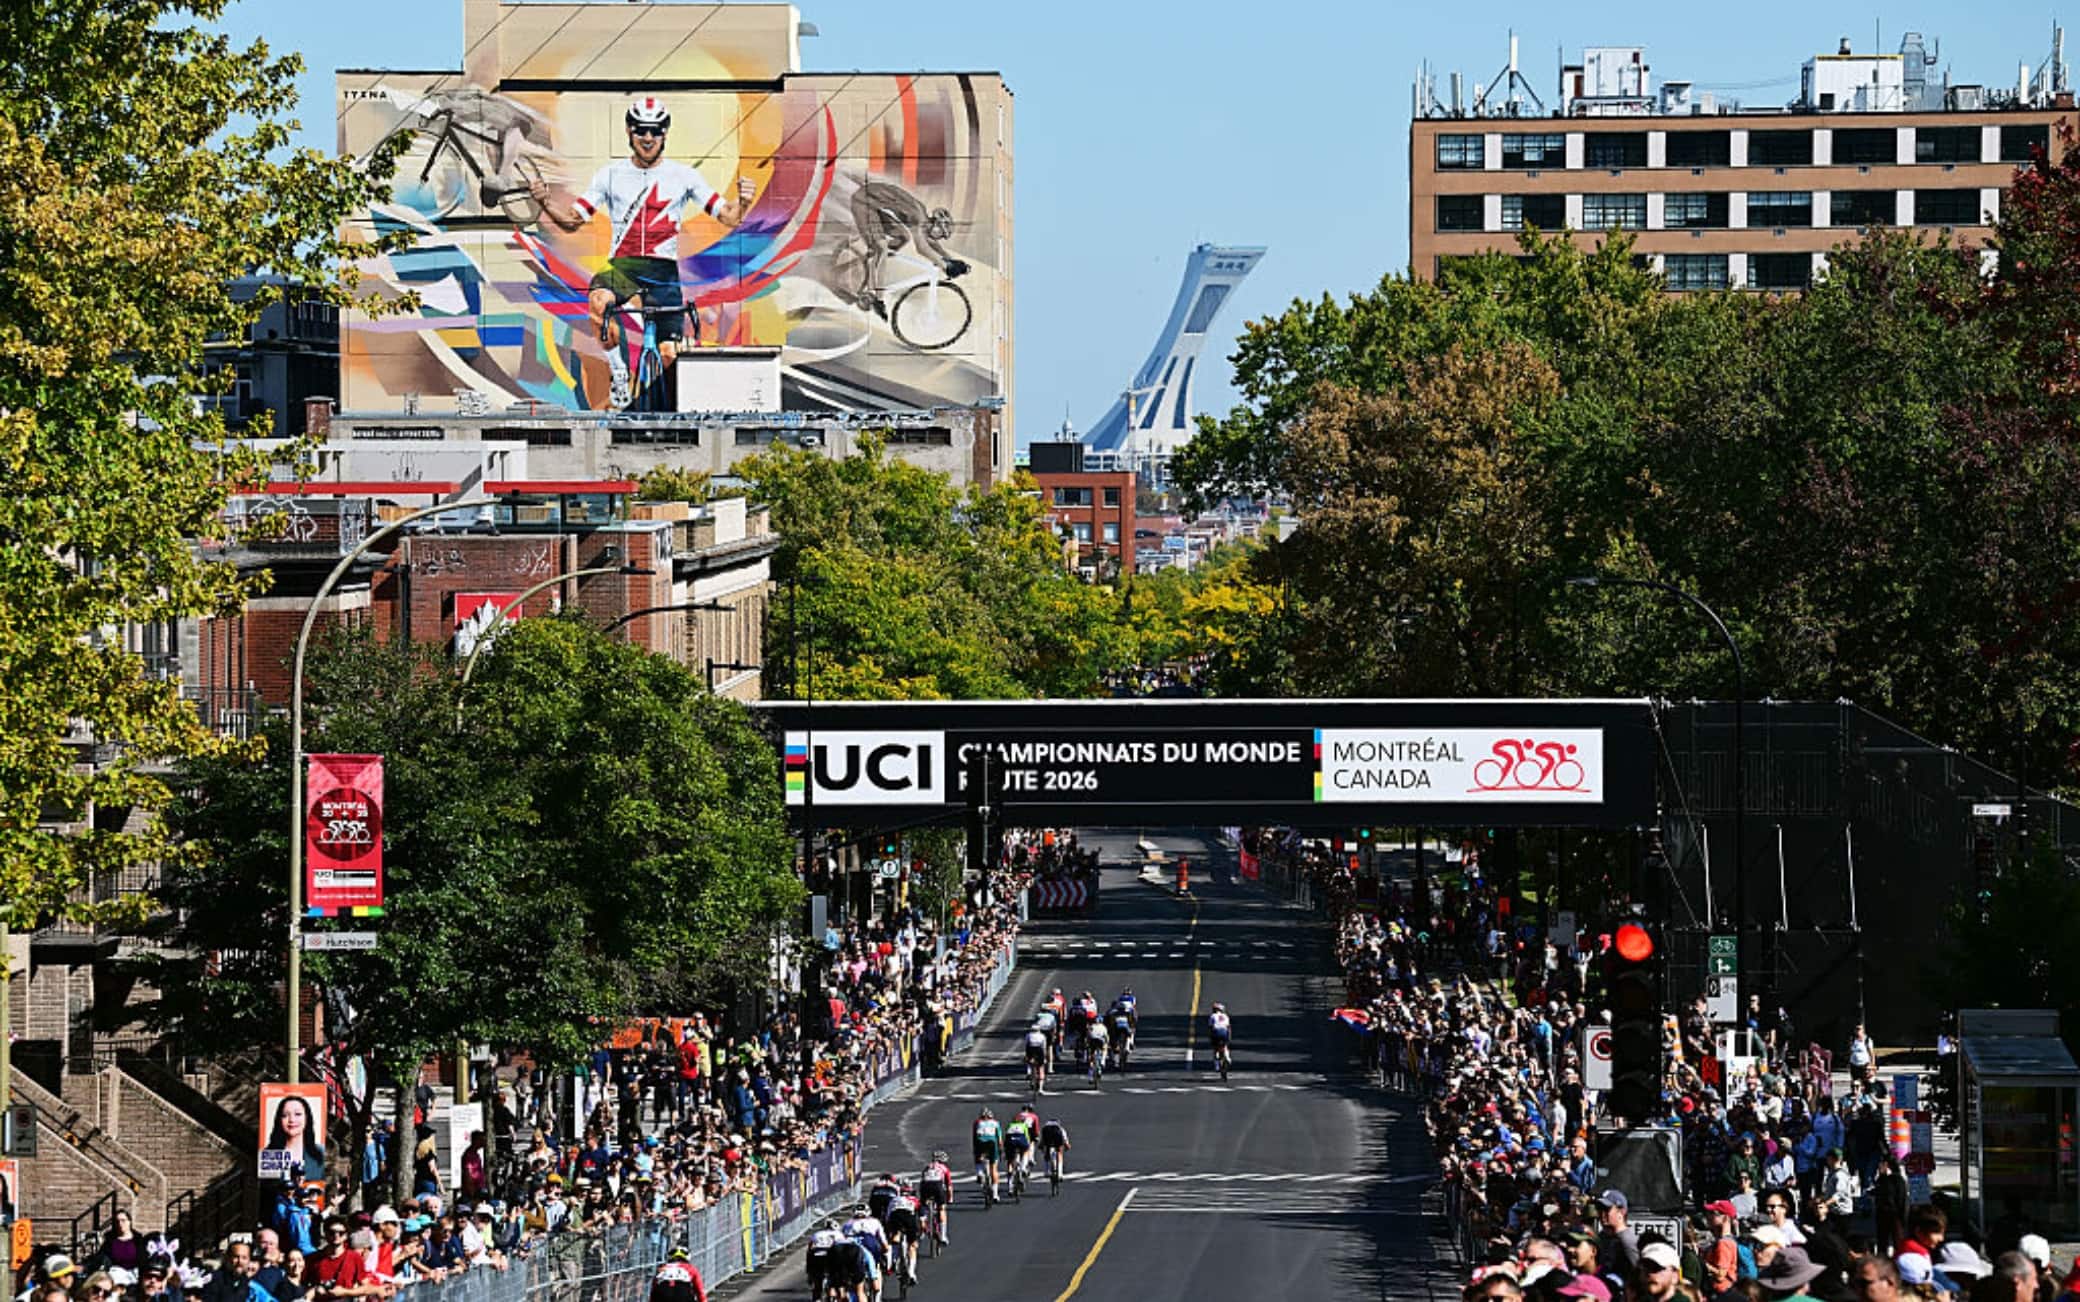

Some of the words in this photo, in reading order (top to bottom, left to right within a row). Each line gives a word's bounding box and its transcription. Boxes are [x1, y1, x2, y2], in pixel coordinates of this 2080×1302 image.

[1163, 742, 1197, 763] DU
[1205, 742, 1301, 763] MONDE
[1333, 737, 1464, 762] MONTRÉAL
[813, 743, 932, 791] UCI
[1043, 770, 1098, 790] 2026
[1333, 769, 1432, 789] CANADA
